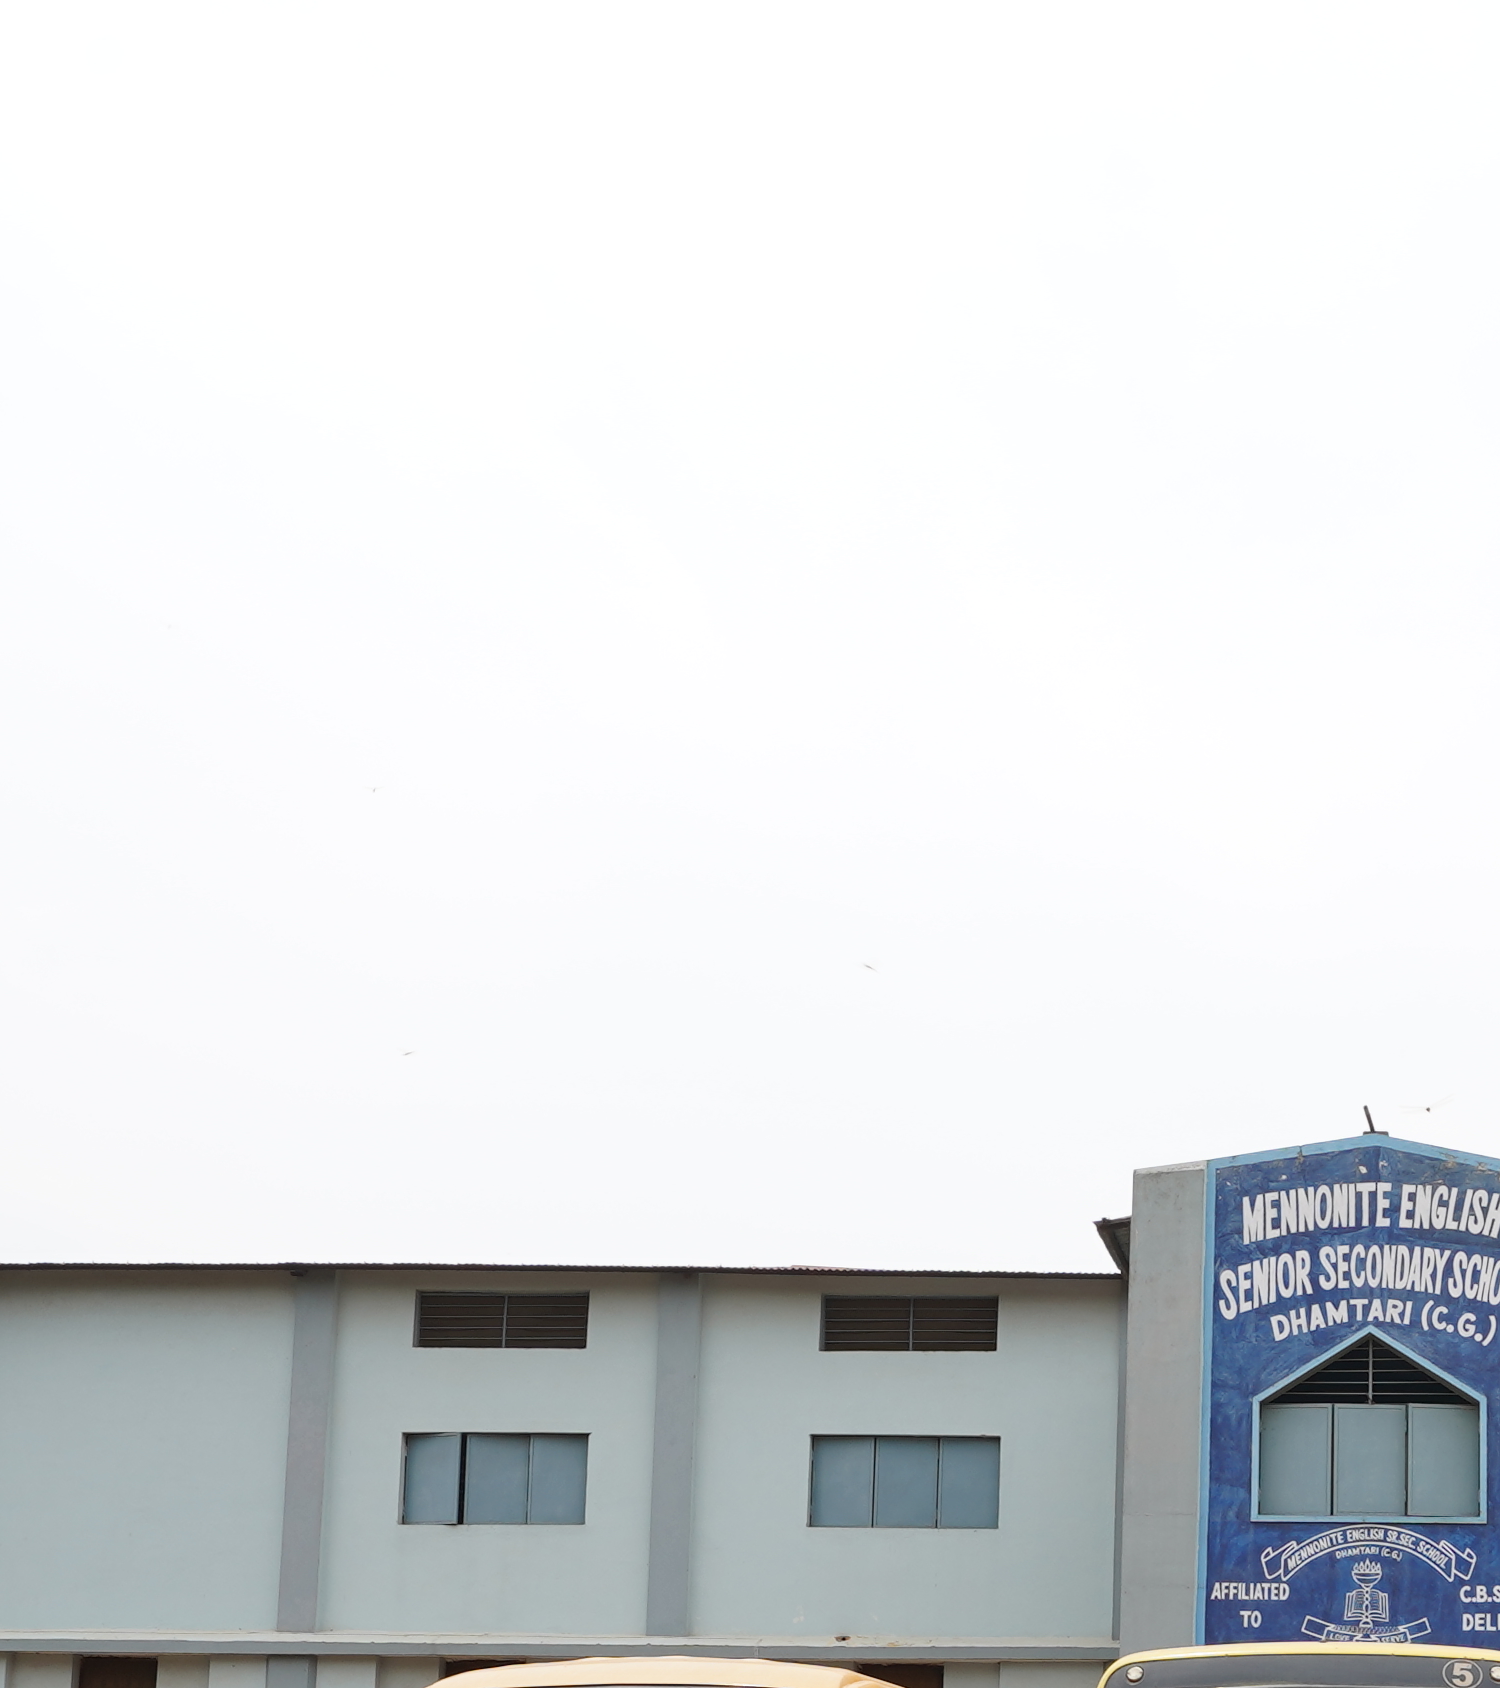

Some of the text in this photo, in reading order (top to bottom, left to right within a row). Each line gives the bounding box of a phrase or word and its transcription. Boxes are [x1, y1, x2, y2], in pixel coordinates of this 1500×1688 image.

[1242, 1182, 1392, 1245] MENNONITE
[1218, 1249, 1313, 1320] SENIOR
[1318, 1244, 1451, 1295] SECONDARY
[1270, 1298, 1497, 1346] DHAMTARI (C.G.)
[1287, 1528, 1451, 1570] MENNONITE ENGLISH SCHOOL
[1335, 1547, 1379, 1559] DHAMTARI
[1210, 1582, 1290, 1601] AFFILIATED
[1239, 1610, 1262, 1628] TO
